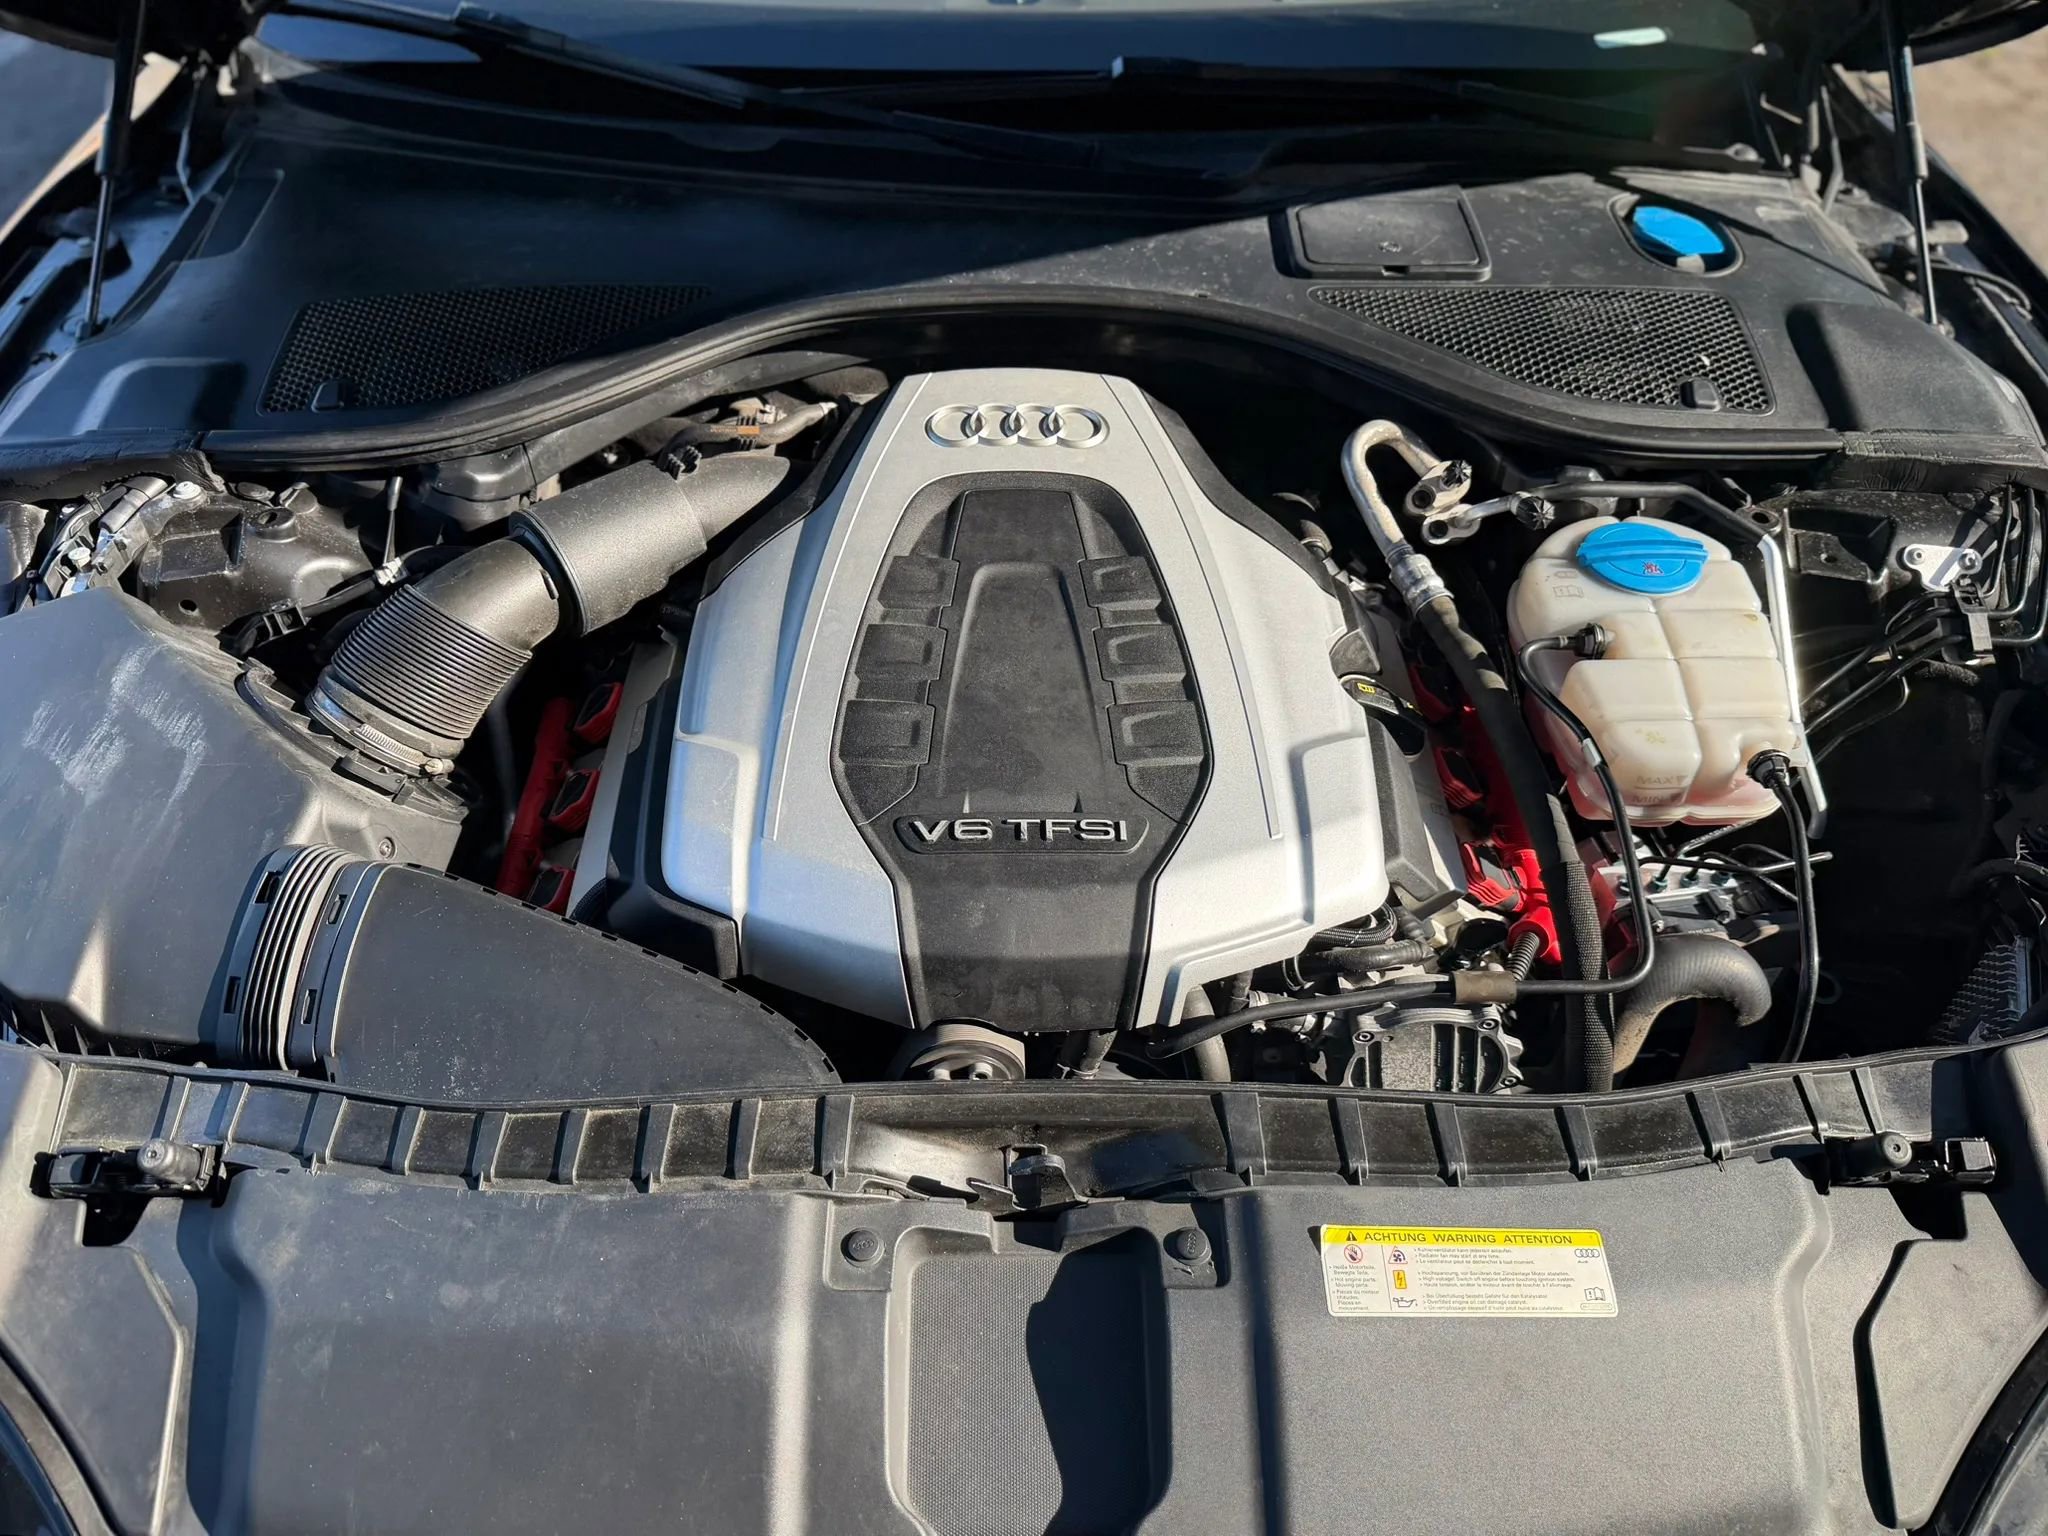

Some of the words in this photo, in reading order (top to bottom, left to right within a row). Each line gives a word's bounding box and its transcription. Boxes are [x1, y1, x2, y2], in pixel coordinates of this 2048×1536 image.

[1636, 775, 1673, 785] MAX
[912, 817, 993, 843] V6
[1004, 817, 1128, 843] TFSI
[1364, 1232, 1426, 1243] ACHTUNG
[1434, 1233, 1497, 1244] WARNING
[1503, 1234, 1573, 1245] ATTENTION
